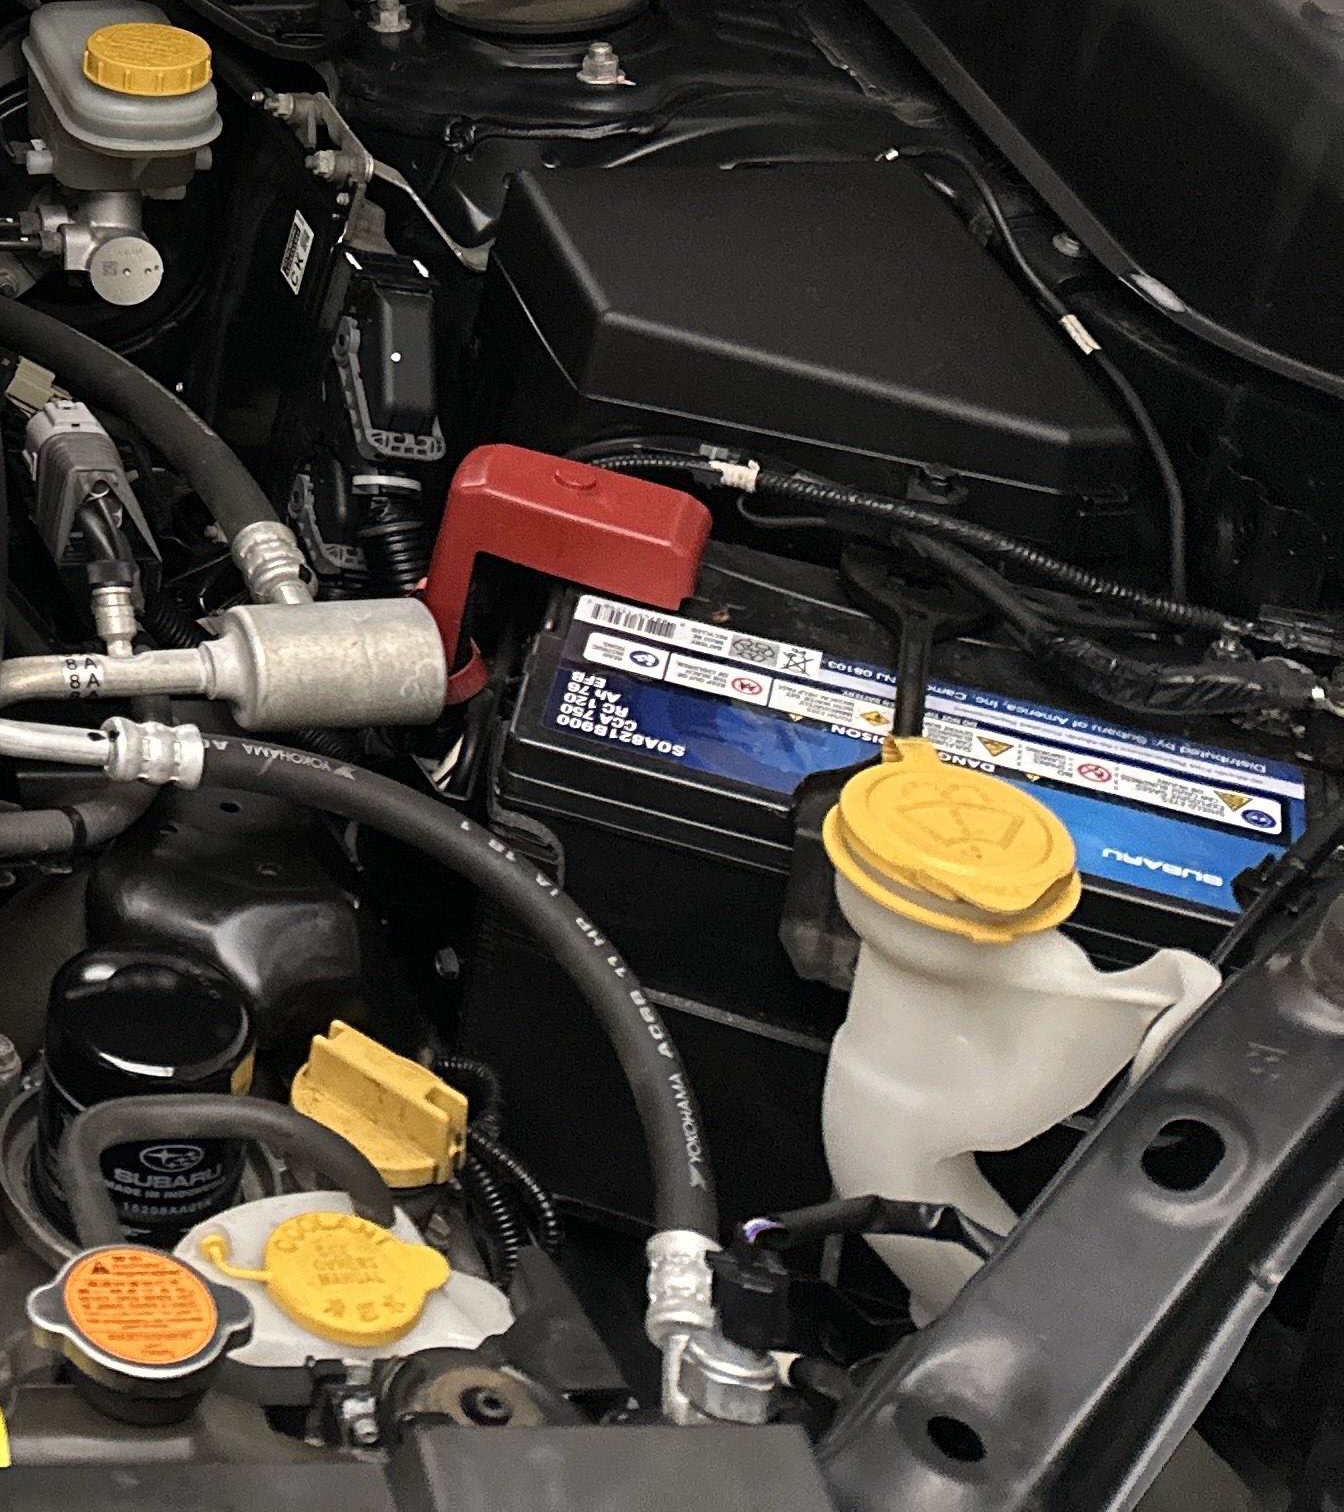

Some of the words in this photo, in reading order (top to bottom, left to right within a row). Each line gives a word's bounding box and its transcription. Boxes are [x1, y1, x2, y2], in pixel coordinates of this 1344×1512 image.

[570, 670, 607, 689] EFB
[875, 672, 897, 684] NJ
[563, 692, 598, 709] 120
[594, 689, 621, 704] Ah
[559, 703, 595, 720] 750
[601, 702, 629, 718] RC
[598, 713, 638, 732] CCA
[1071, 719, 1088, 731] of
[1091, 724, 1148, 745] Subaru
[241, 742, 332, 772] YOKOHAMA
[937, 752, 996, 773] DANG
[1178, 745, 1267, 773] Distributed
[1101, 847, 1224, 888] SUBARU
[576, 918, 604, 946] HP
[668, 1073, 701, 1165] YOKOHAMA
[114, 1162, 223, 1189] SUBARU
